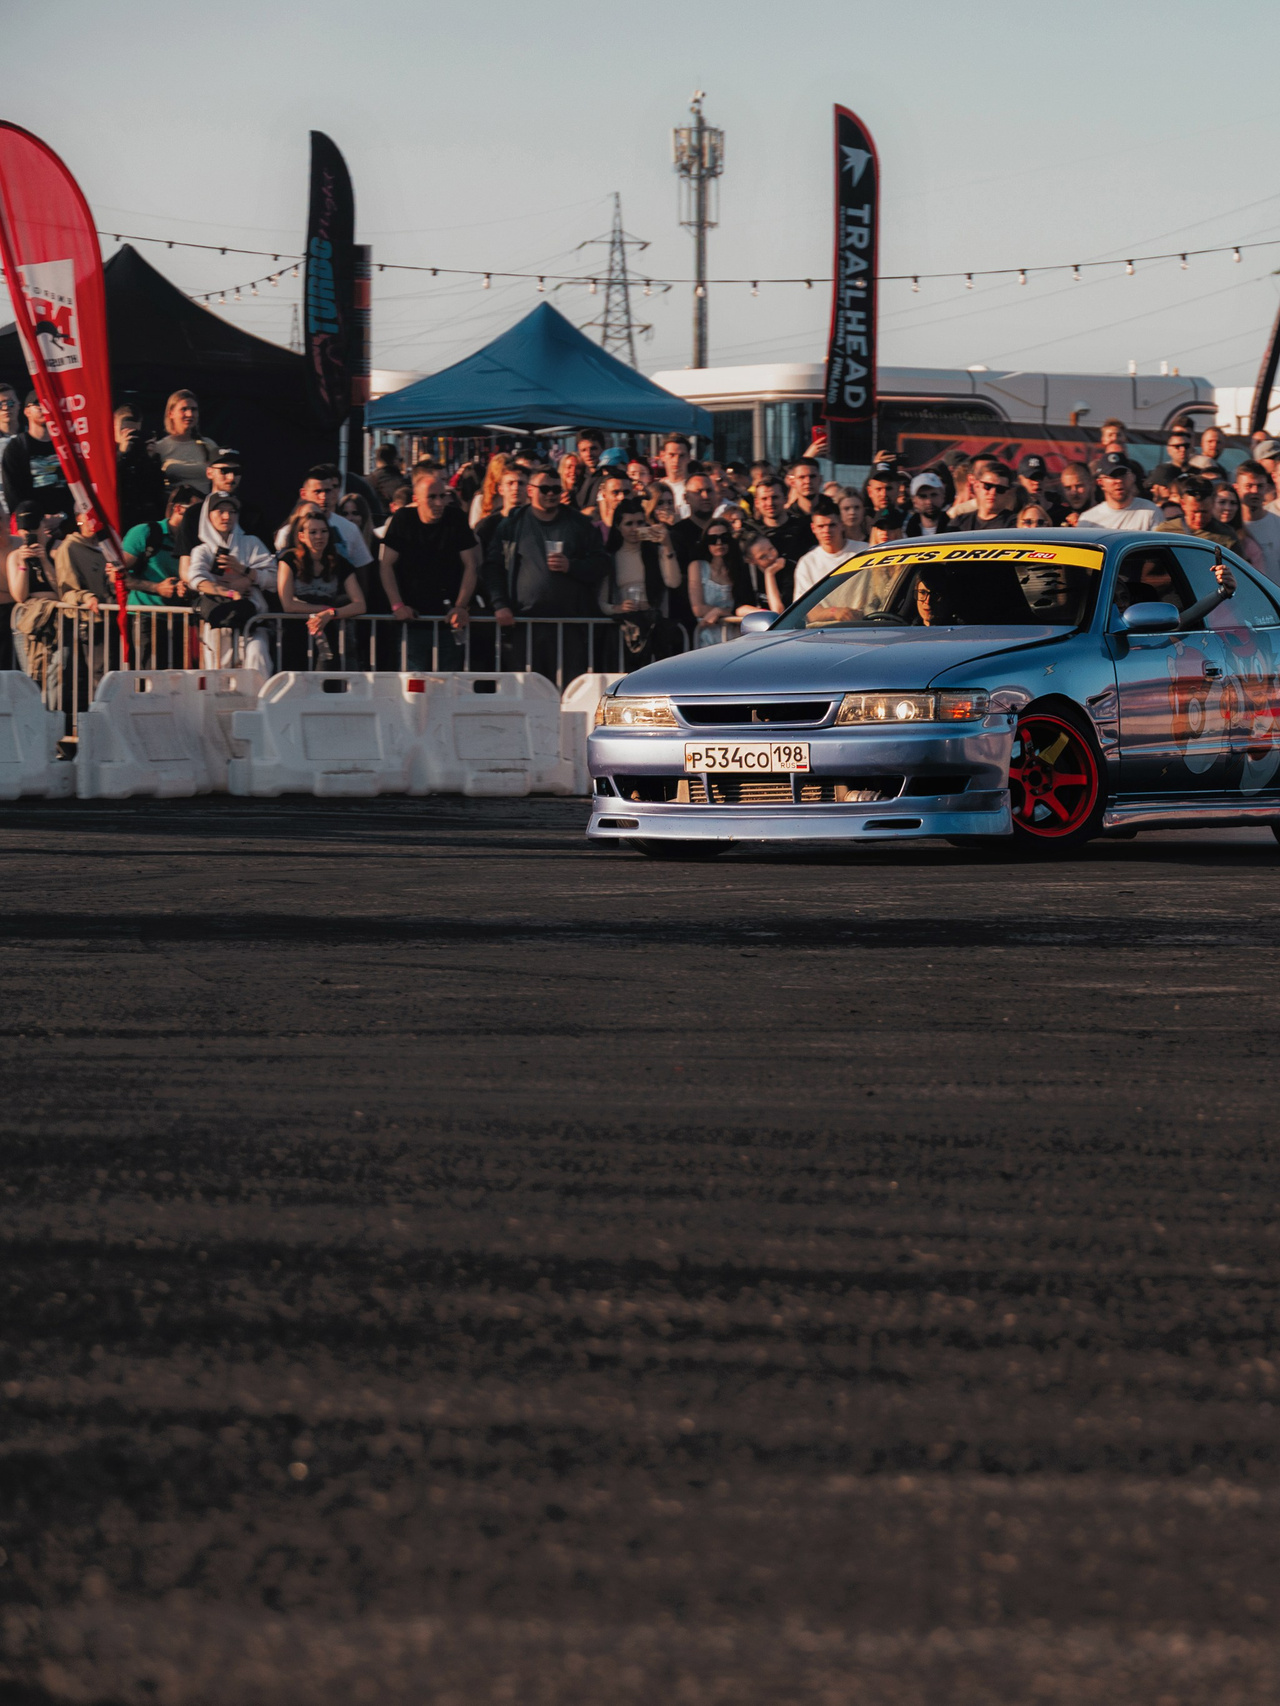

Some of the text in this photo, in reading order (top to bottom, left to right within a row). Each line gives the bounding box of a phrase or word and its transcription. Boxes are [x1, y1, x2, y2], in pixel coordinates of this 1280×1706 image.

[308, 236, 339, 335] TURBO
[844, 203, 871, 408] TRAILHEAD
[859, 550, 941, 569] LET'S
[943, 549, 1034, 560] DRIFT
[773, 746, 803, 762] 198
